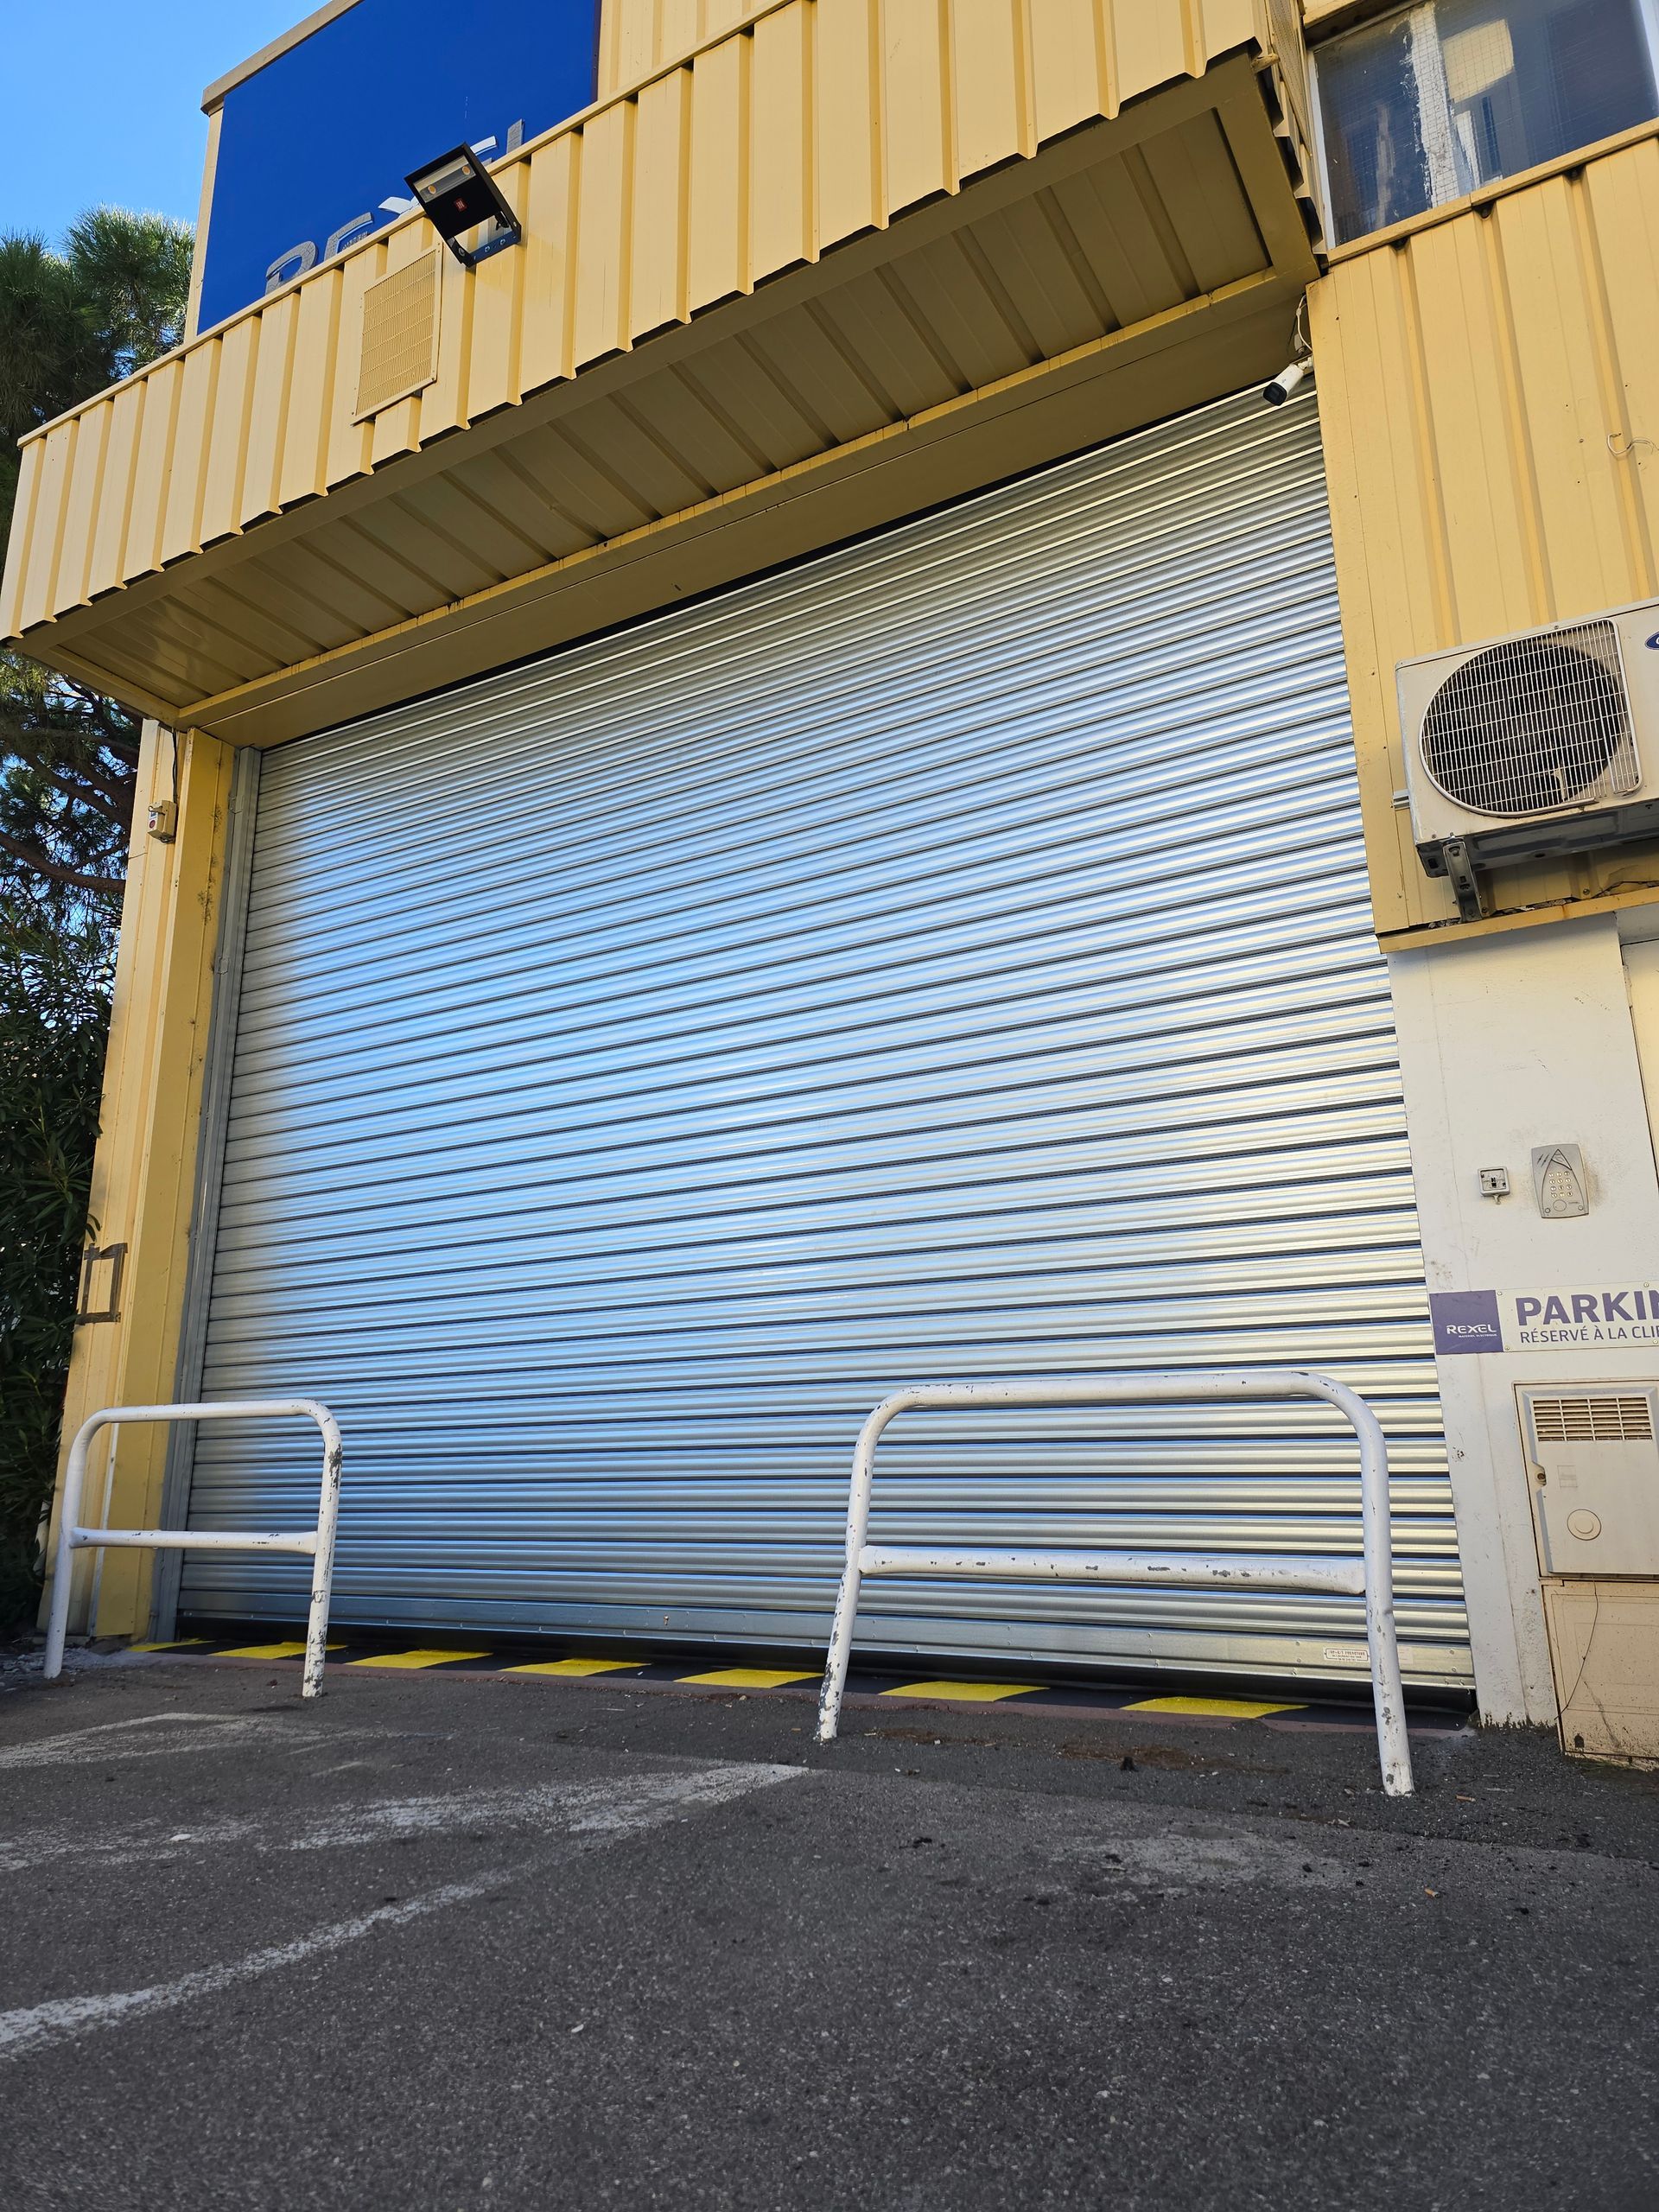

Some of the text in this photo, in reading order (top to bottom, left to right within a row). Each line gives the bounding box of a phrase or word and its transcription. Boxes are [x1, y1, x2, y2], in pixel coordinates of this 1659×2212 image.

[1520, 1325, 1590, 1344] RÉSERVÉ
[1593, 1325, 1605, 1340] À
[1607, 1326, 1628, 1339] LA
